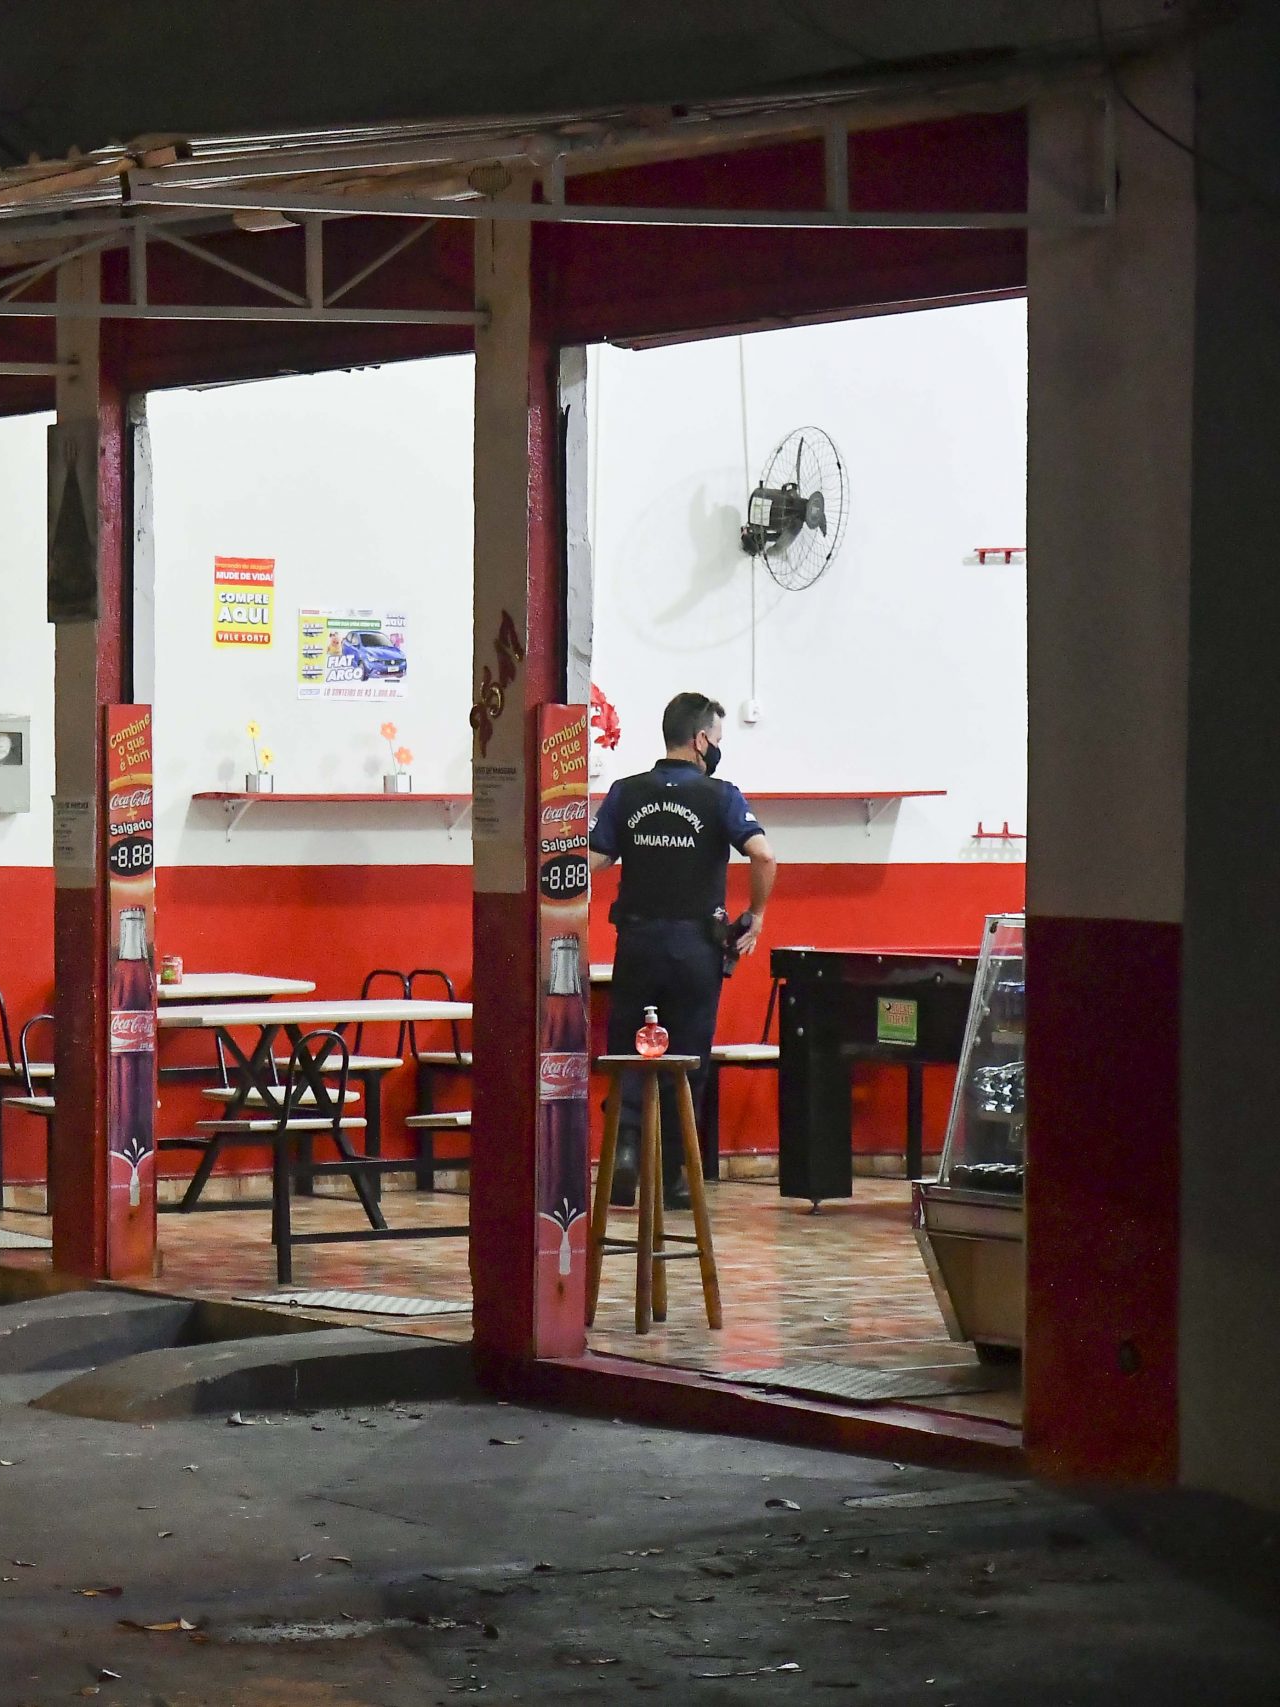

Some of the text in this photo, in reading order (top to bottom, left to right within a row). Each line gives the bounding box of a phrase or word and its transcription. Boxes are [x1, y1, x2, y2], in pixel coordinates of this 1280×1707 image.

[216, 571, 240, 580] MUDE
[240, 572, 252, 580] DE
[219, 592, 270, 605] COMPRE
[218, 606, 268, 624] AQUI
[218, 632, 269, 642] VALE SORTE
[327, 655, 354, 668] FIAT
[326, 668, 363, 682] ARGO
[118, 736, 146, 756] o que
[551, 740, 580, 762] o que
[128, 748, 150, 766] bom
[552, 756, 586, 781] é bom
[110, 789, 152, 810] Coca-Cola
[542, 800, 587, 824] Coca-Cola
[627, 801, 705, 834] GUARDA MUNICIPAL
[110, 819, 152, 836] Salgado
[542, 834, 587, 852] Salgado
[633, 834, 696, 848] UMUARAMA
